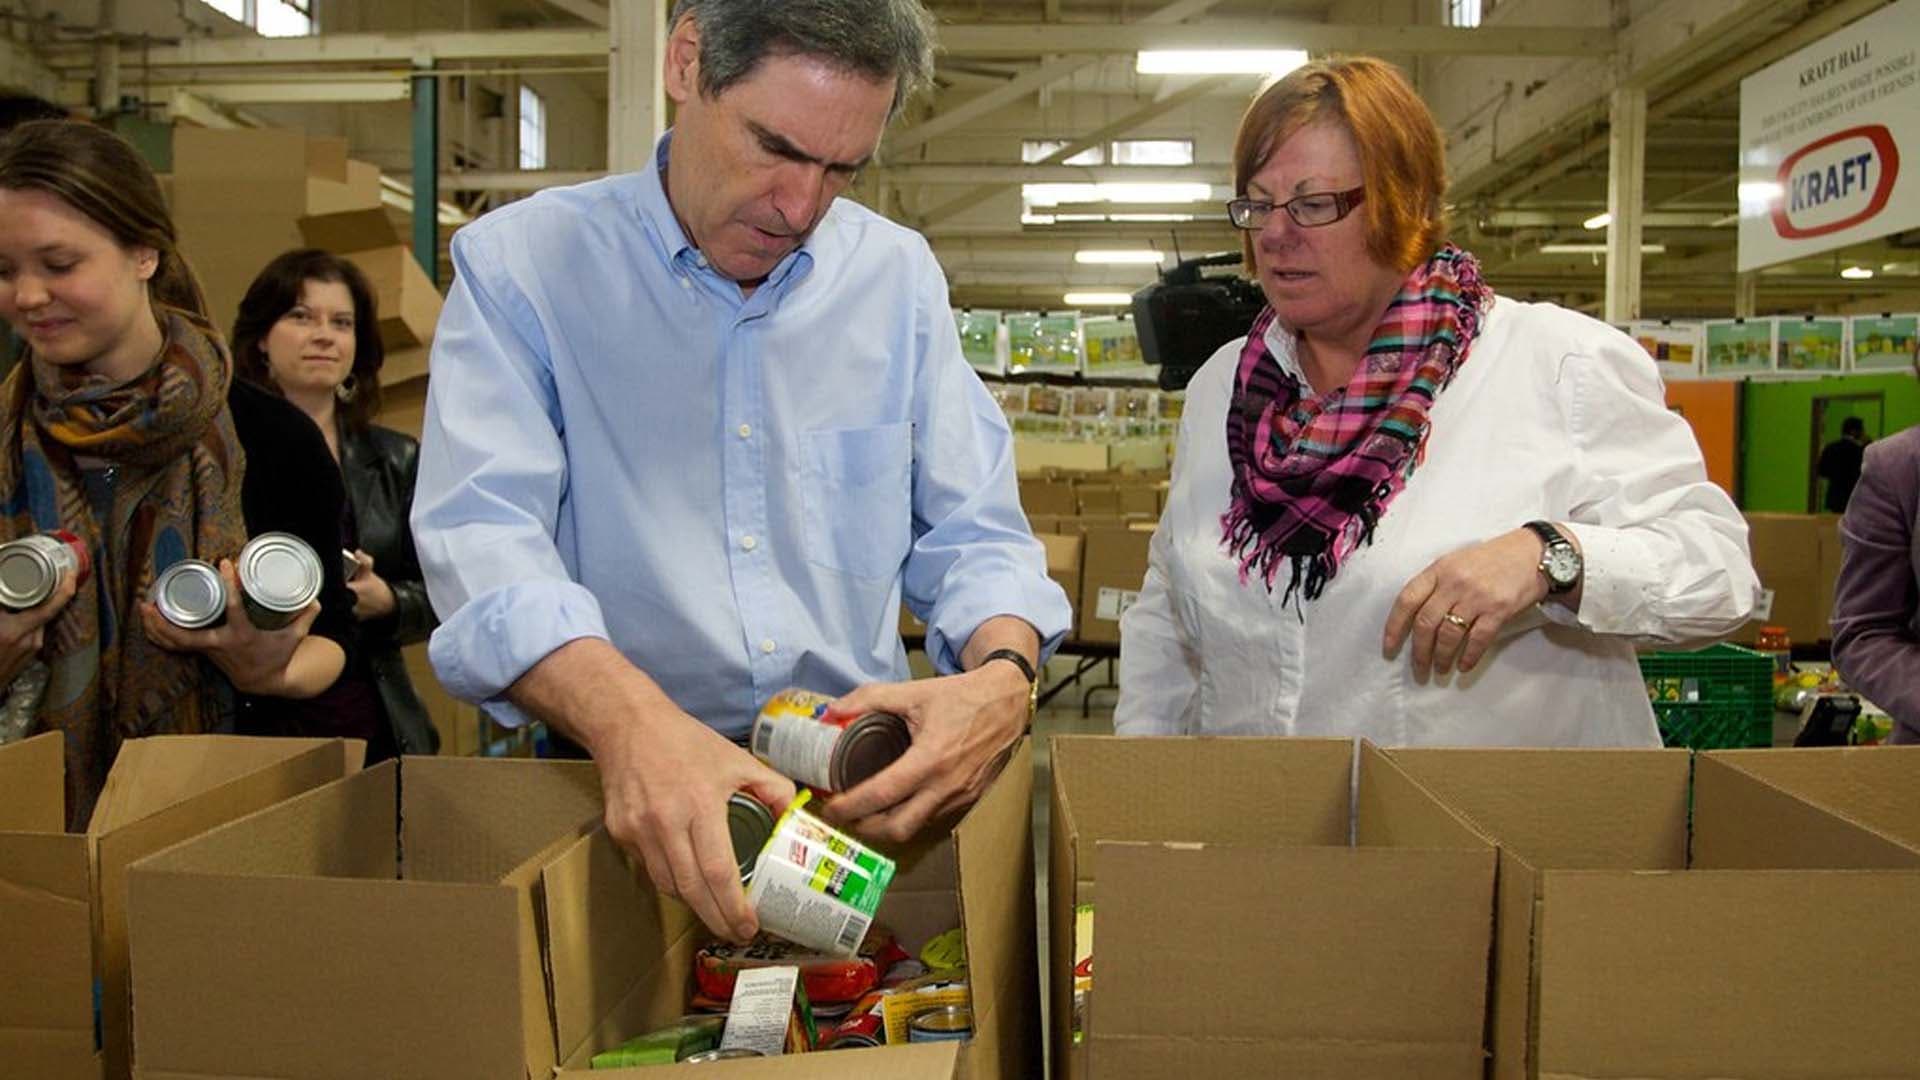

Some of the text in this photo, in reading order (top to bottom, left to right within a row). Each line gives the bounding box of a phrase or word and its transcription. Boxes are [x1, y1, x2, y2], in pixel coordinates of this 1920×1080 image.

[1799, 41, 1871, 87] KRAFT HALL
[1791, 152, 1872, 213] KRAFT
